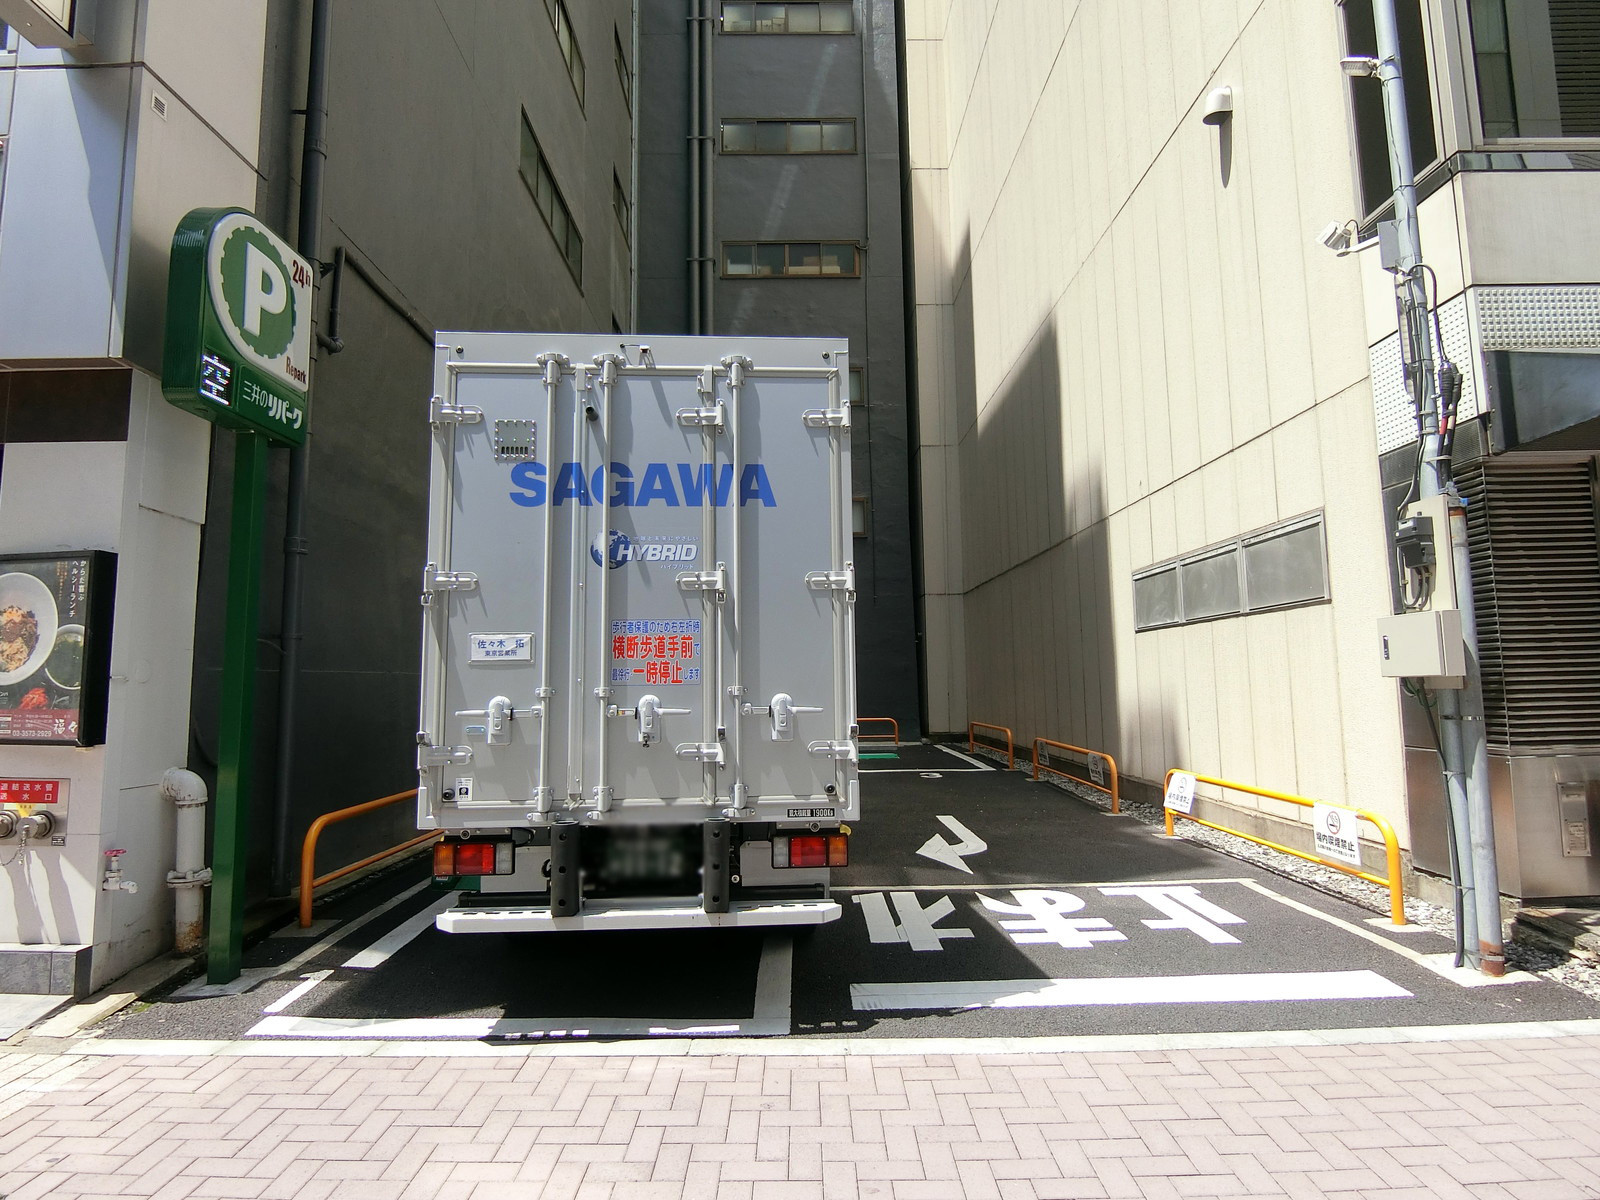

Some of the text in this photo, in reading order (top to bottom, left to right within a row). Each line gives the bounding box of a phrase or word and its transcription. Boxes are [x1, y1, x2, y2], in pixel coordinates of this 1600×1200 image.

[243, 242, 287, 336] P
[292, 259, 311, 289] 24h
[285, 355, 307, 385] Repark
[243, 380, 302, 429] 三井のリパーク
[509, 461, 777, 508] SAGAWA
[616, 543, 698, 562] HYBRID
[68, 560, 79, 618] ヘルシーランチ
[612, 620, 700, 633] 歩行者保護のため右左折時
[477, 639, 506, 649] 佐々木
[612, 635, 700, 659] 横断歩道手前で
